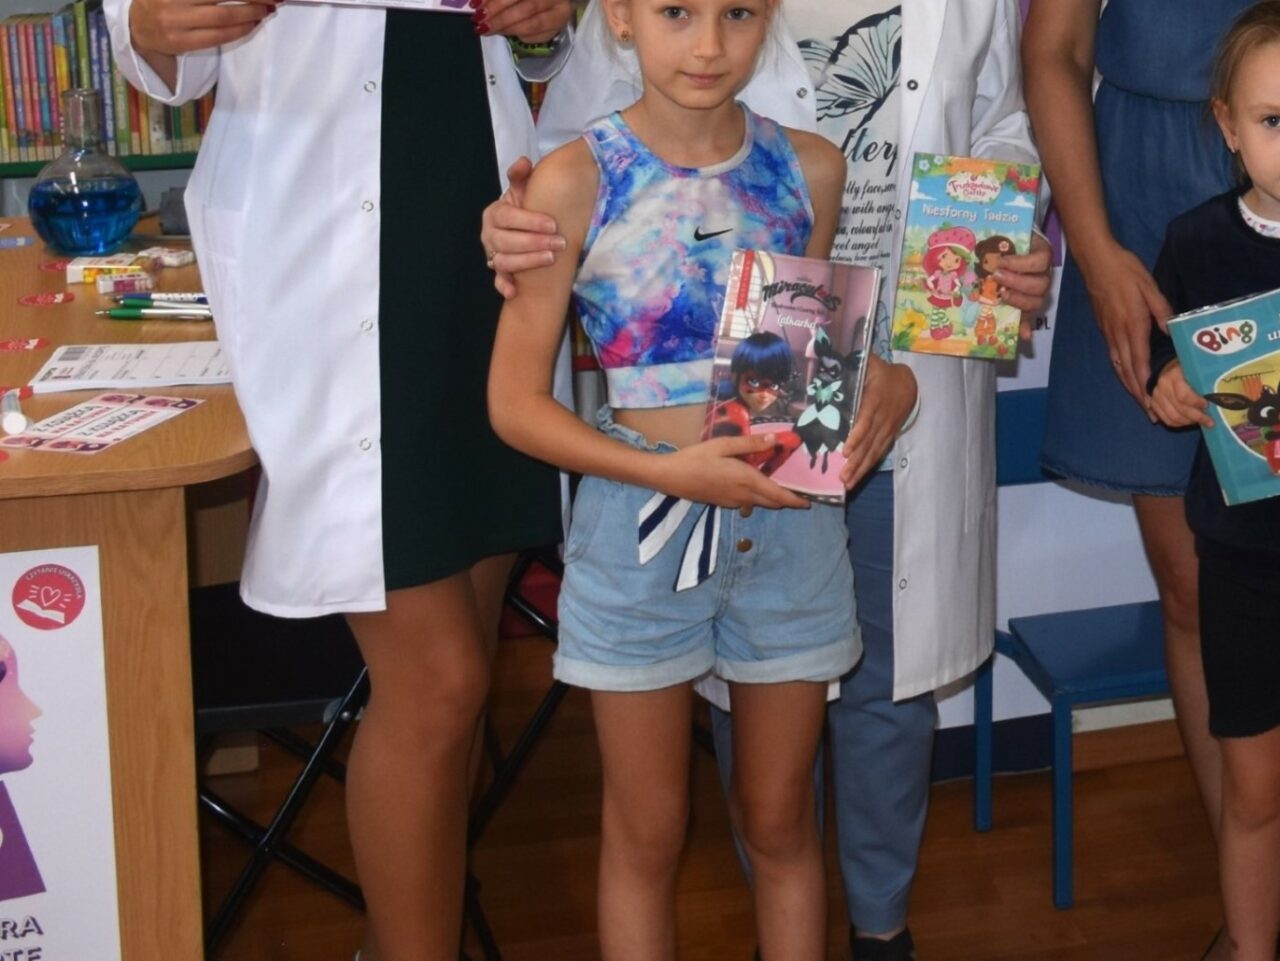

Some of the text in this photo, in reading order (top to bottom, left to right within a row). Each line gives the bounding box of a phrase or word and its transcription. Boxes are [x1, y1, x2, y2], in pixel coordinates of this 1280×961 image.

[922, 203, 1019, 223] Niesforny Tadzio
[1196, 320, 1254, 352] Bing
